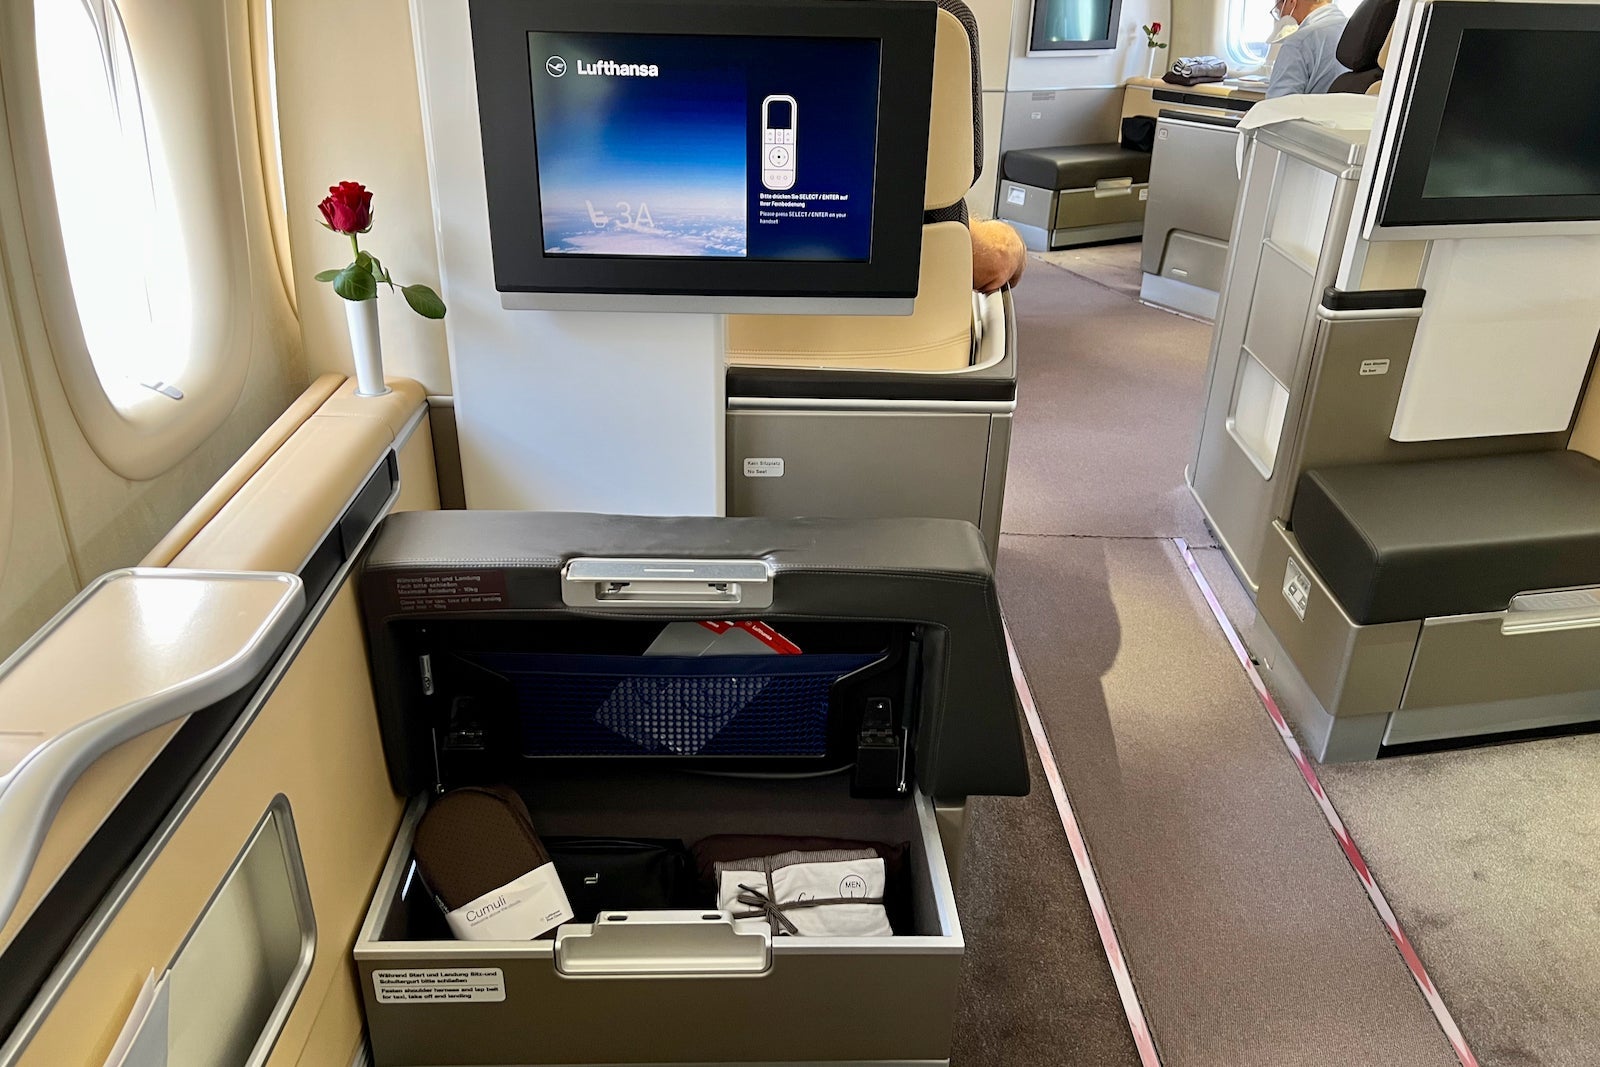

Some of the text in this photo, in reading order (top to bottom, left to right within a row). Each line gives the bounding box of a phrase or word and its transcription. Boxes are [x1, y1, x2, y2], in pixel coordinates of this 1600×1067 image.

[577, 60, 659, 77] Lufthansa
[616, 201, 655, 228] 3A
[466, 895, 507, 922] Cumuli
